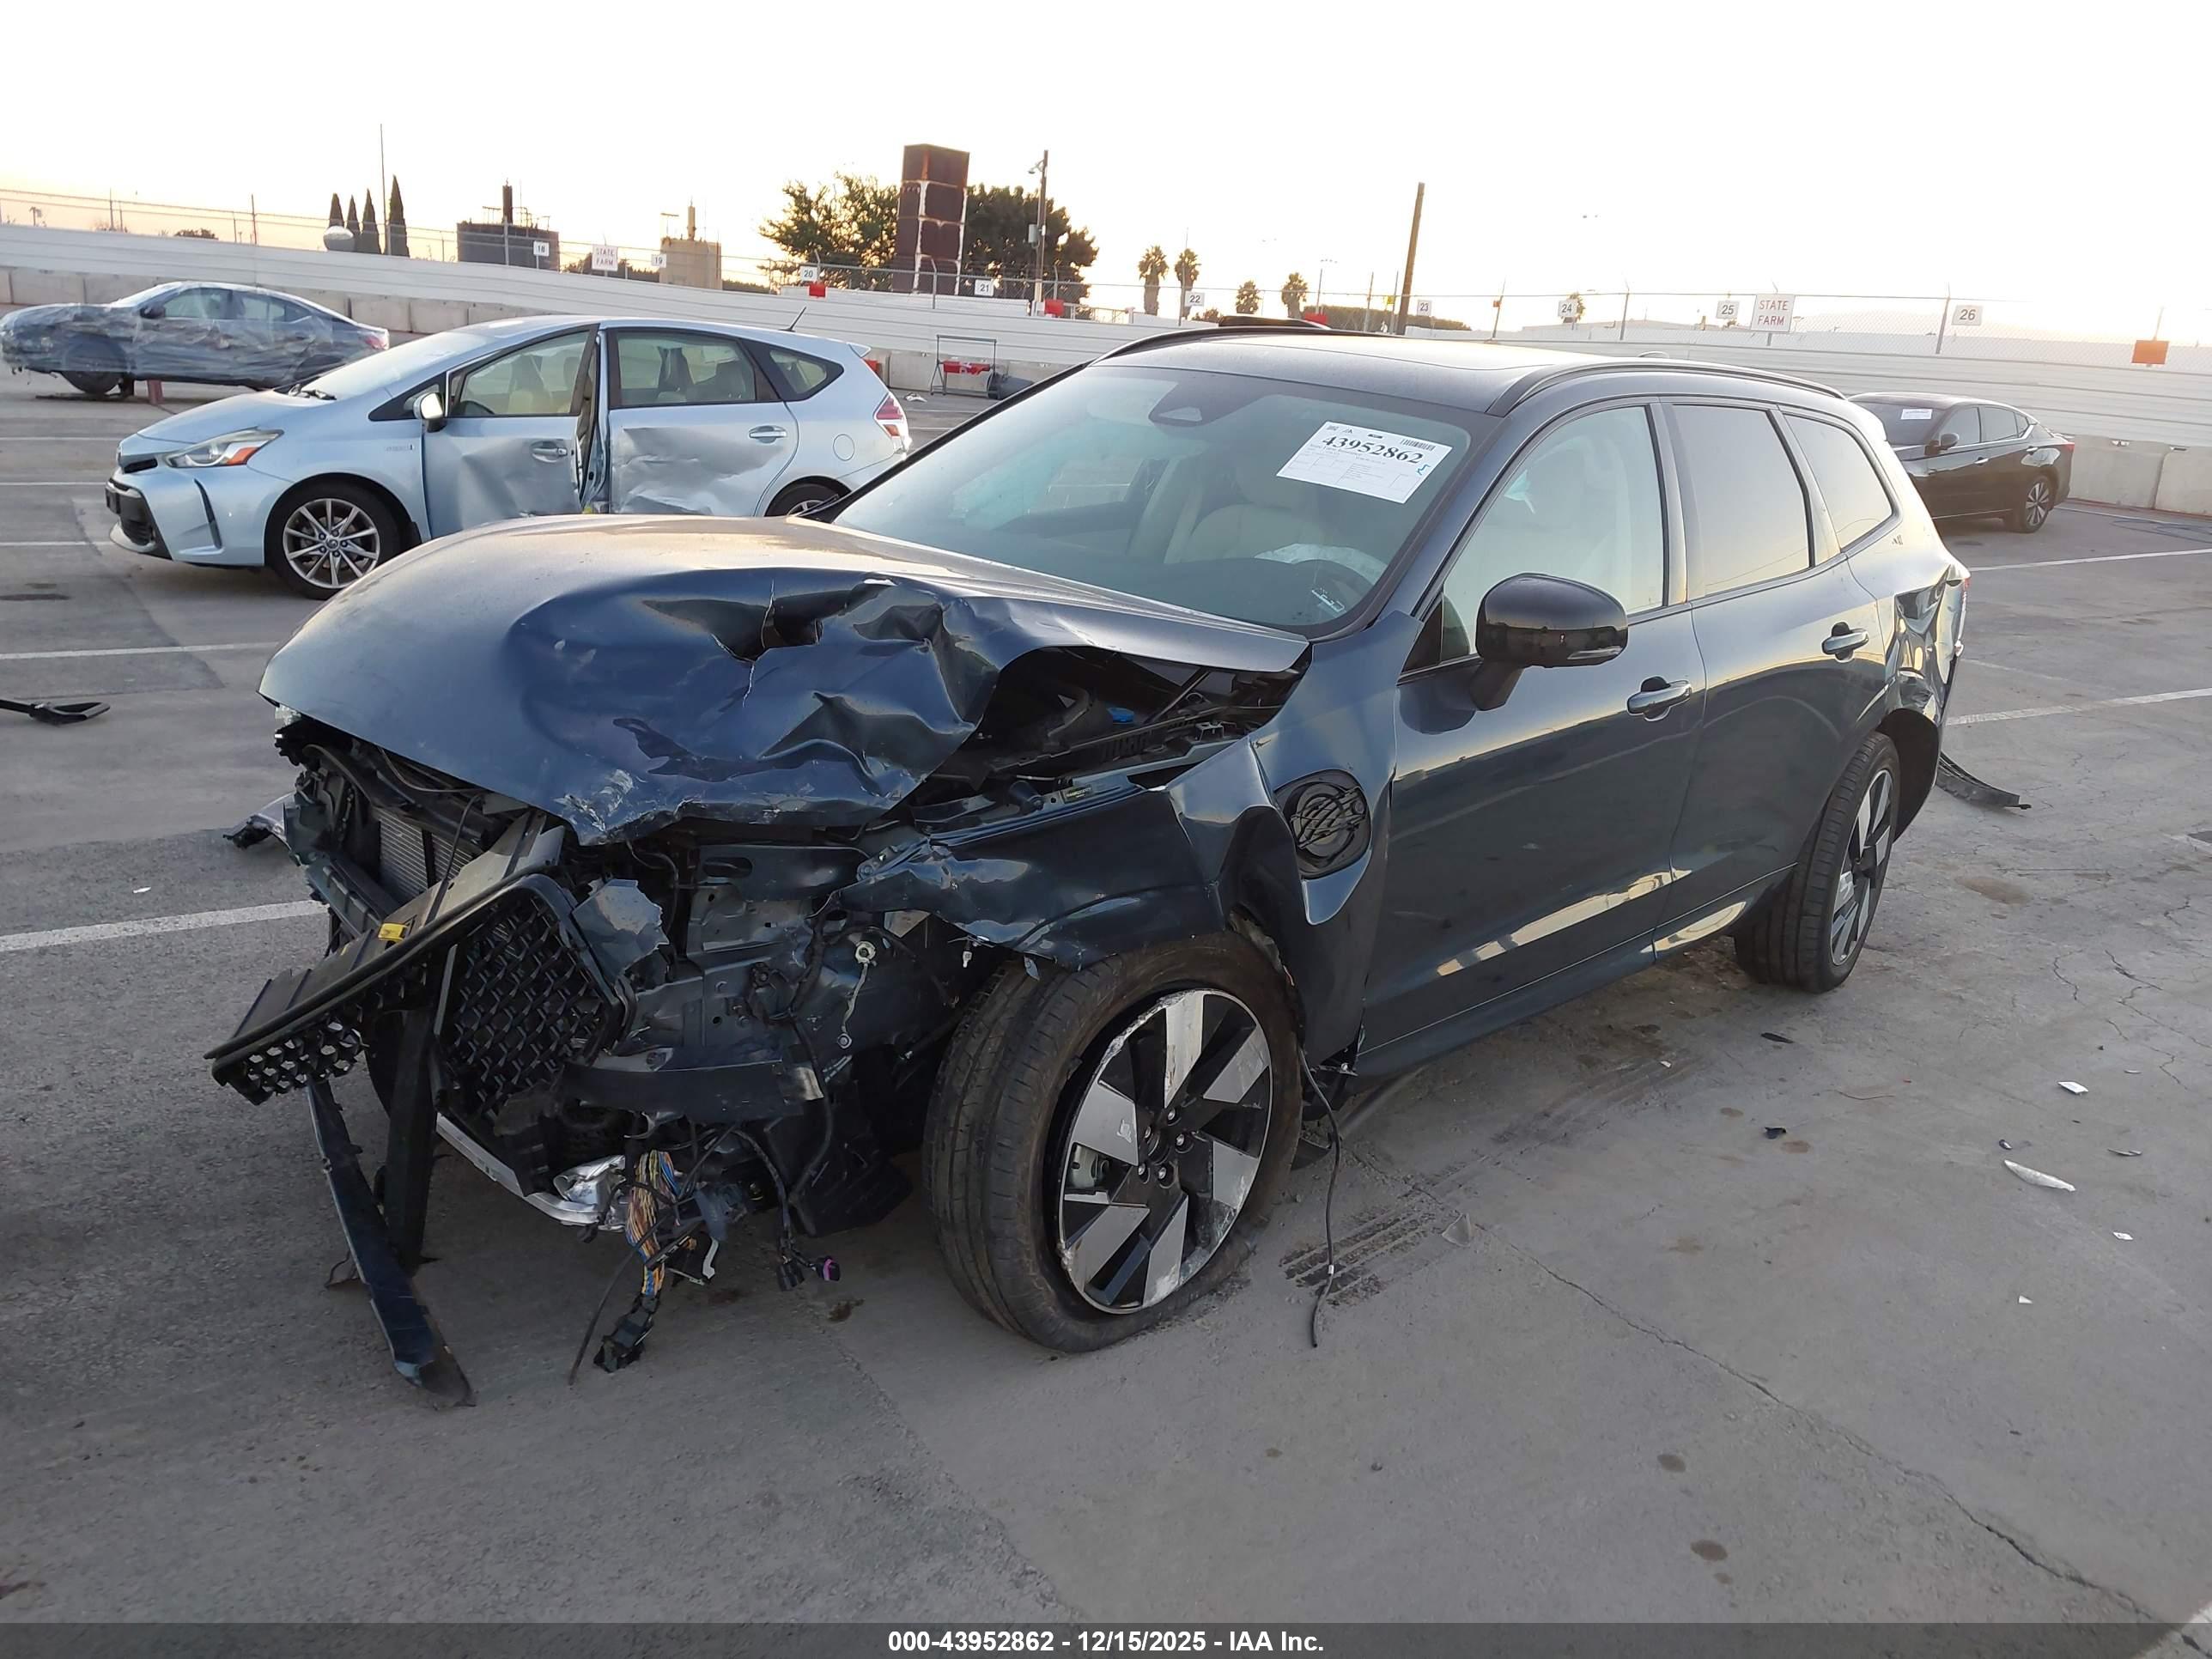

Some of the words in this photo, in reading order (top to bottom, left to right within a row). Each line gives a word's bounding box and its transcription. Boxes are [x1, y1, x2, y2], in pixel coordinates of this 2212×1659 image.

[595, 257, 614, 266] FARM
[654, 256, 664, 265] 19
[804, 269, 814, 279] 20
[980, 283, 989, 293] 21
[1189, 295, 1200, 304] 22
[1419, 302, 1429, 312] 23
[1561, 302, 1572, 313] 24
[1721, 304, 1735, 315] 25
[1759, 300, 1789, 311] STATE
[1960, 309, 1976, 320] 26
[1758, 315, 1785, 325] FARM
[1322, 435, 1424, 464] 43952862
